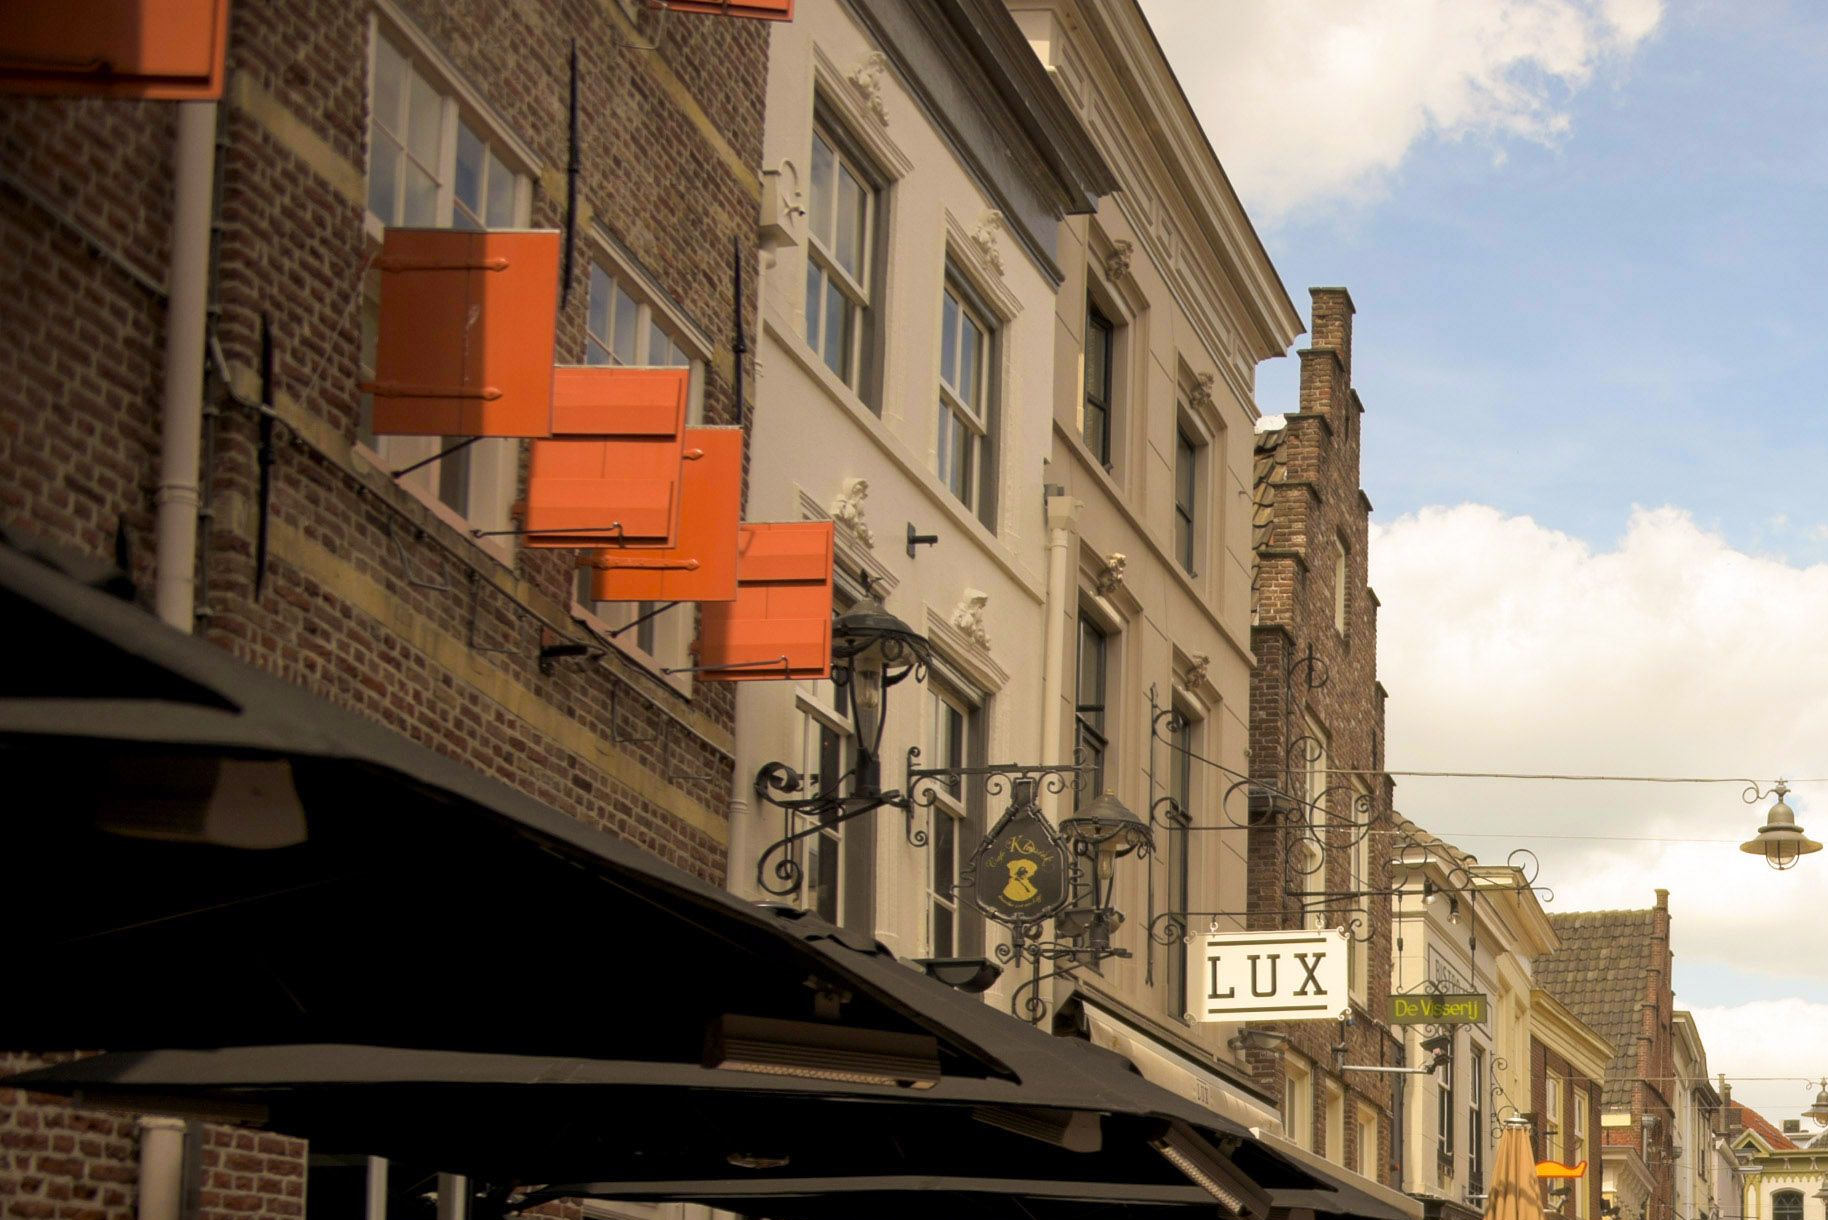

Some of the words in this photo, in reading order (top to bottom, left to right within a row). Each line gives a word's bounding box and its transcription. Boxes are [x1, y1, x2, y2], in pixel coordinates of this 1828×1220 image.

[1207, 952, 1328, 999] LUX
[1395, 1000, 1419, 1017] De
[1420, 999, 1479, 1020] Visserij
